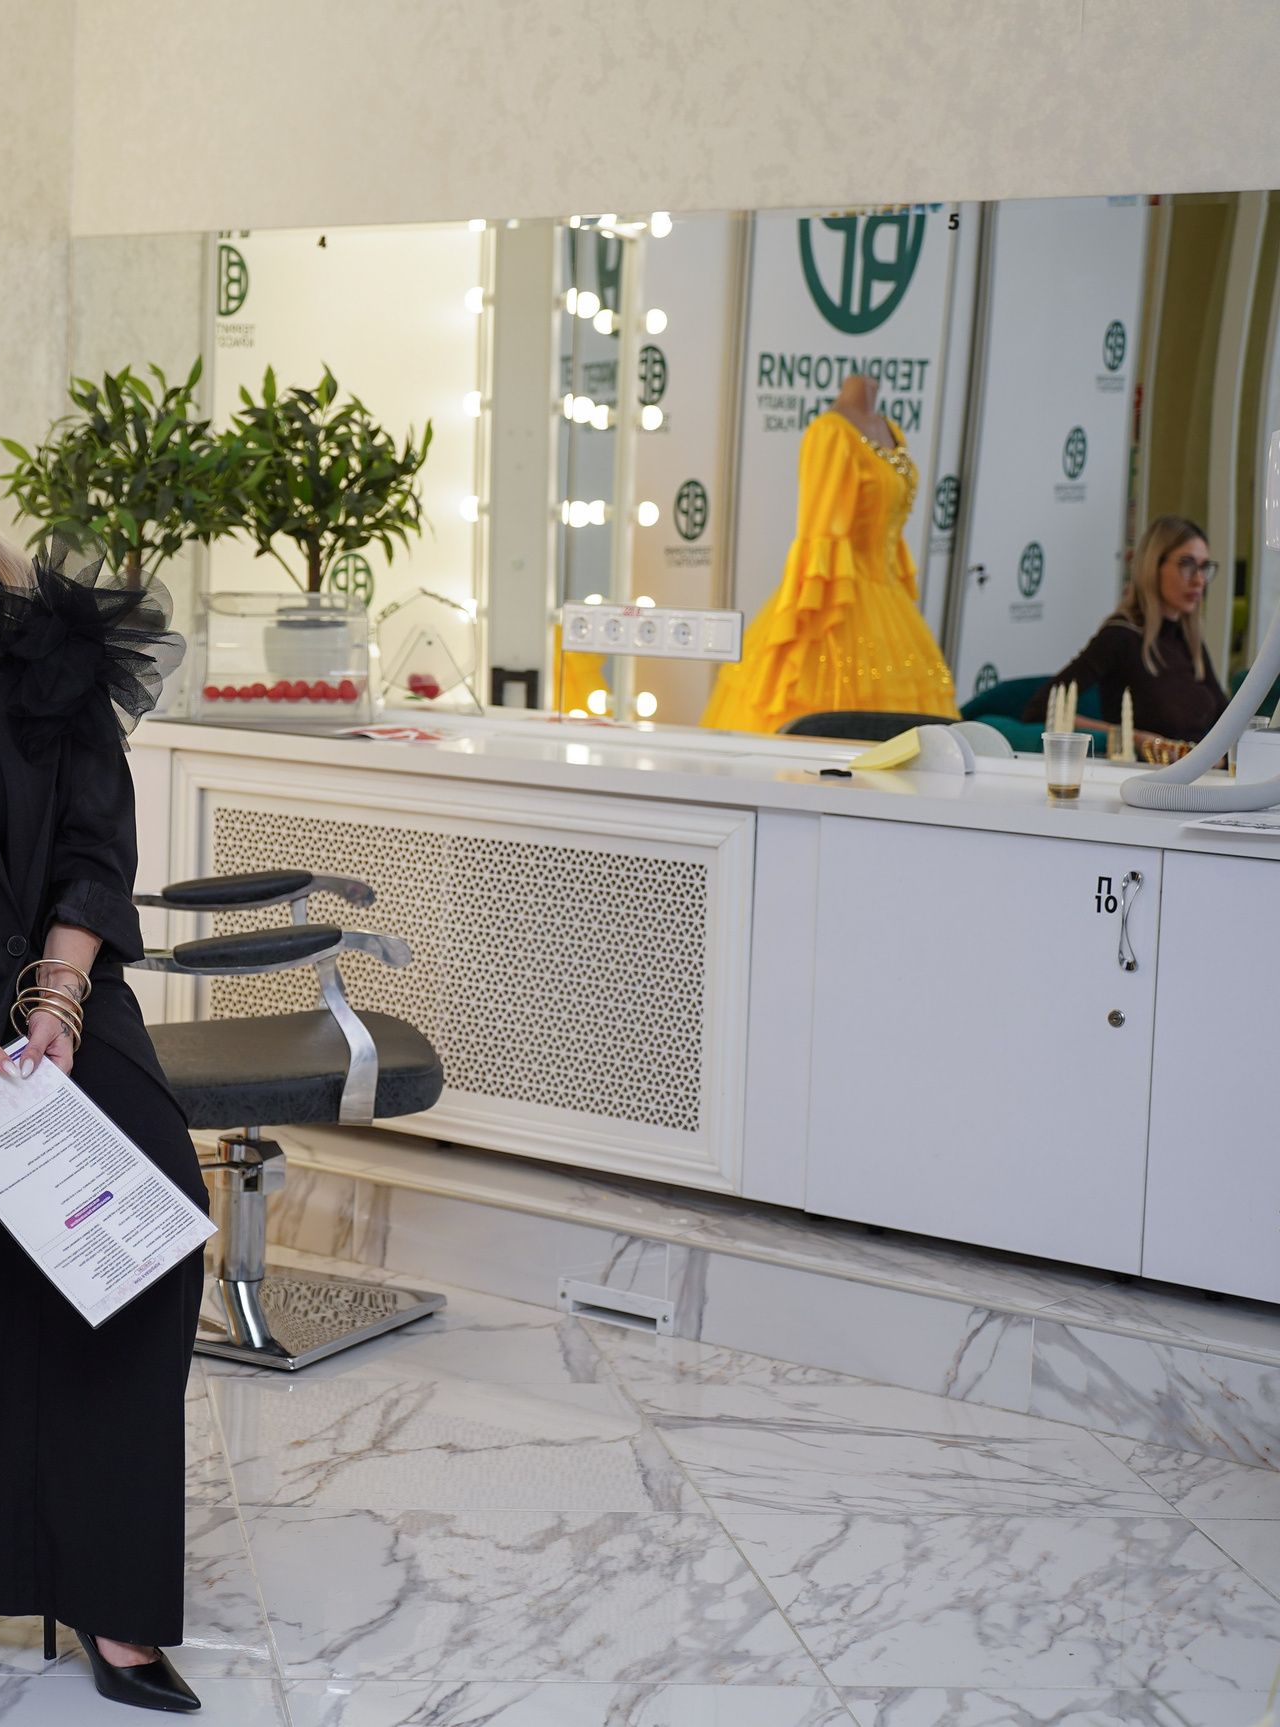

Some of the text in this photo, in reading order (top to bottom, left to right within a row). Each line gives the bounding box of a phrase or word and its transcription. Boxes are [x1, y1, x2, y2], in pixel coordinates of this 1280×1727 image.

[948, 213, 960, 230] 5
[317, 235, 326, 248] 4
[1097, 876, 1112, 895] П
[1095, 895, 1118, 914] 10
